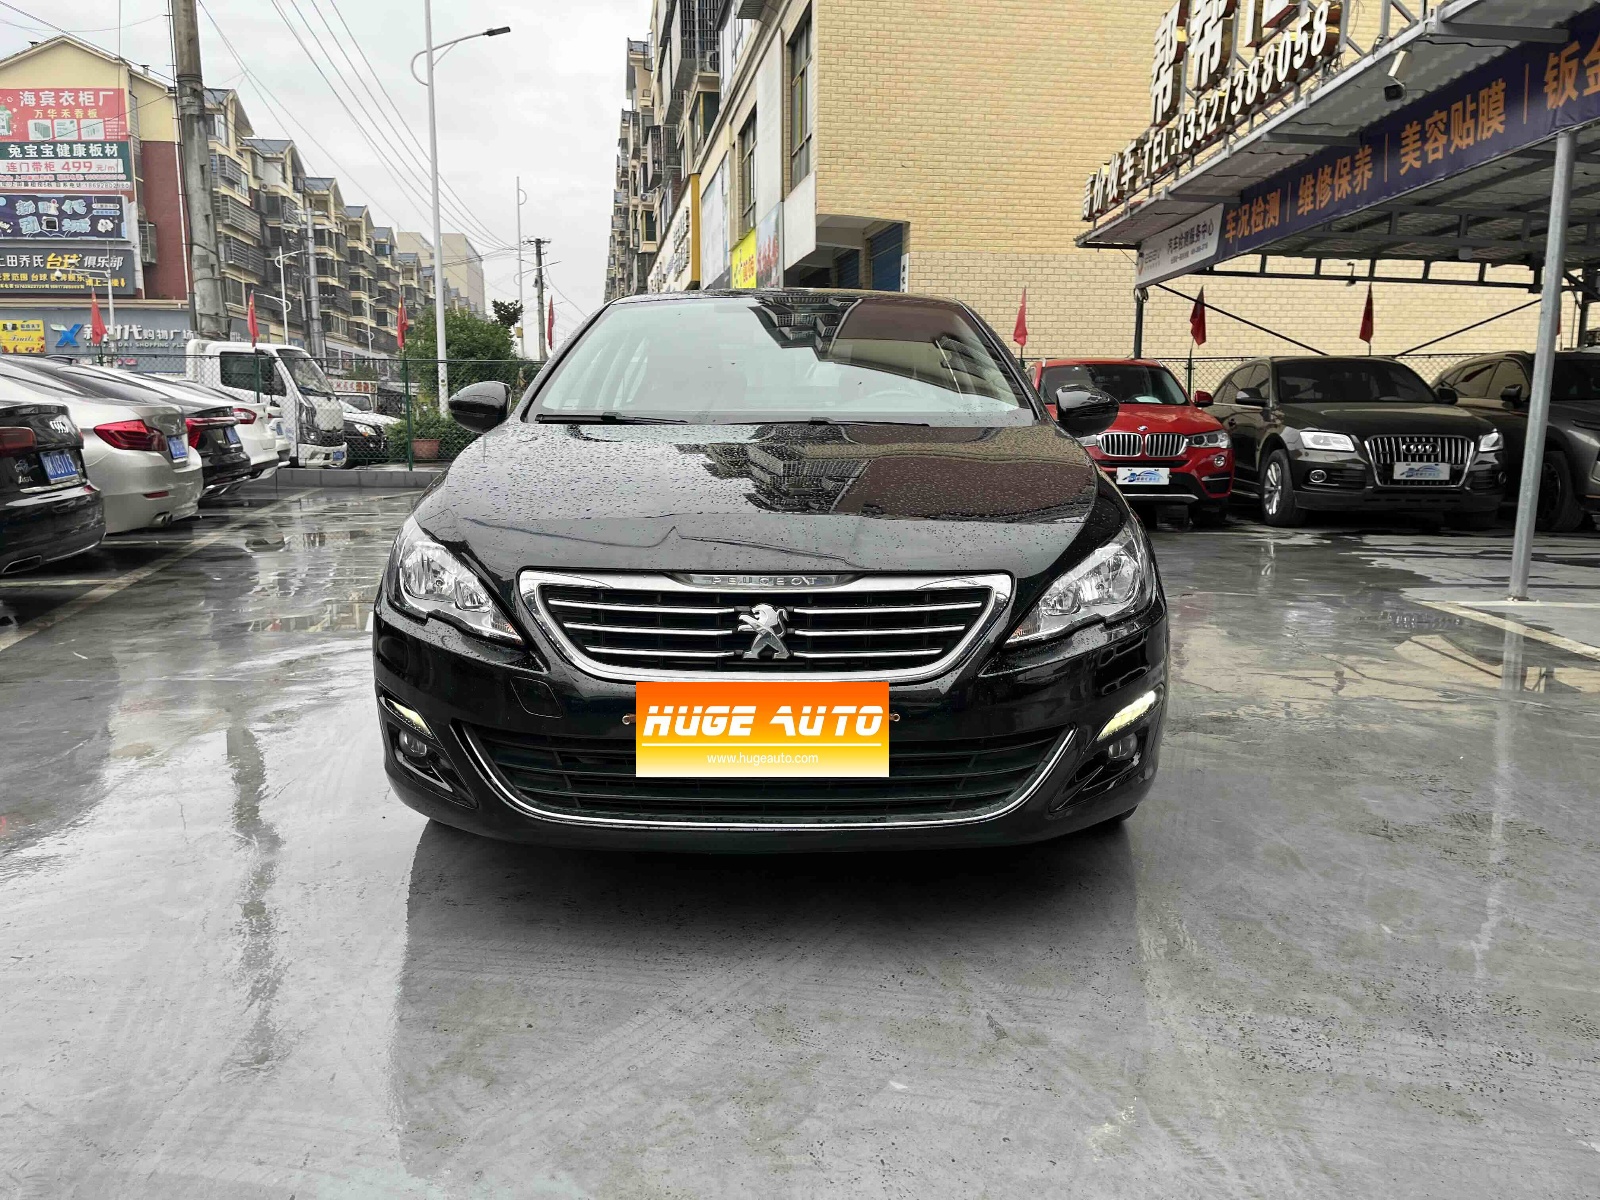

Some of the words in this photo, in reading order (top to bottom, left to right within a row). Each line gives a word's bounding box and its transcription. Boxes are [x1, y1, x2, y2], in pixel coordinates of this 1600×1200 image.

[1151, 0, 1291, 126] 帮帮
[19, 91, 113, 107] 海宾衣柜厂
[34, 109, 98, 119] 万华禾香板
[8, 143, 118, 158] 兔宝宝健康板材
[6, 162, 55, 173] 连门带柜
[61, 161, 93, 172] 499
[1225, 188, 1281, 243] 车况检测
[1297, 145, 1373, 216] 维修保养
[1399, 78, 1507, 176] 美容贴膜
[711, 576, 818, 586] PEUGEOT
